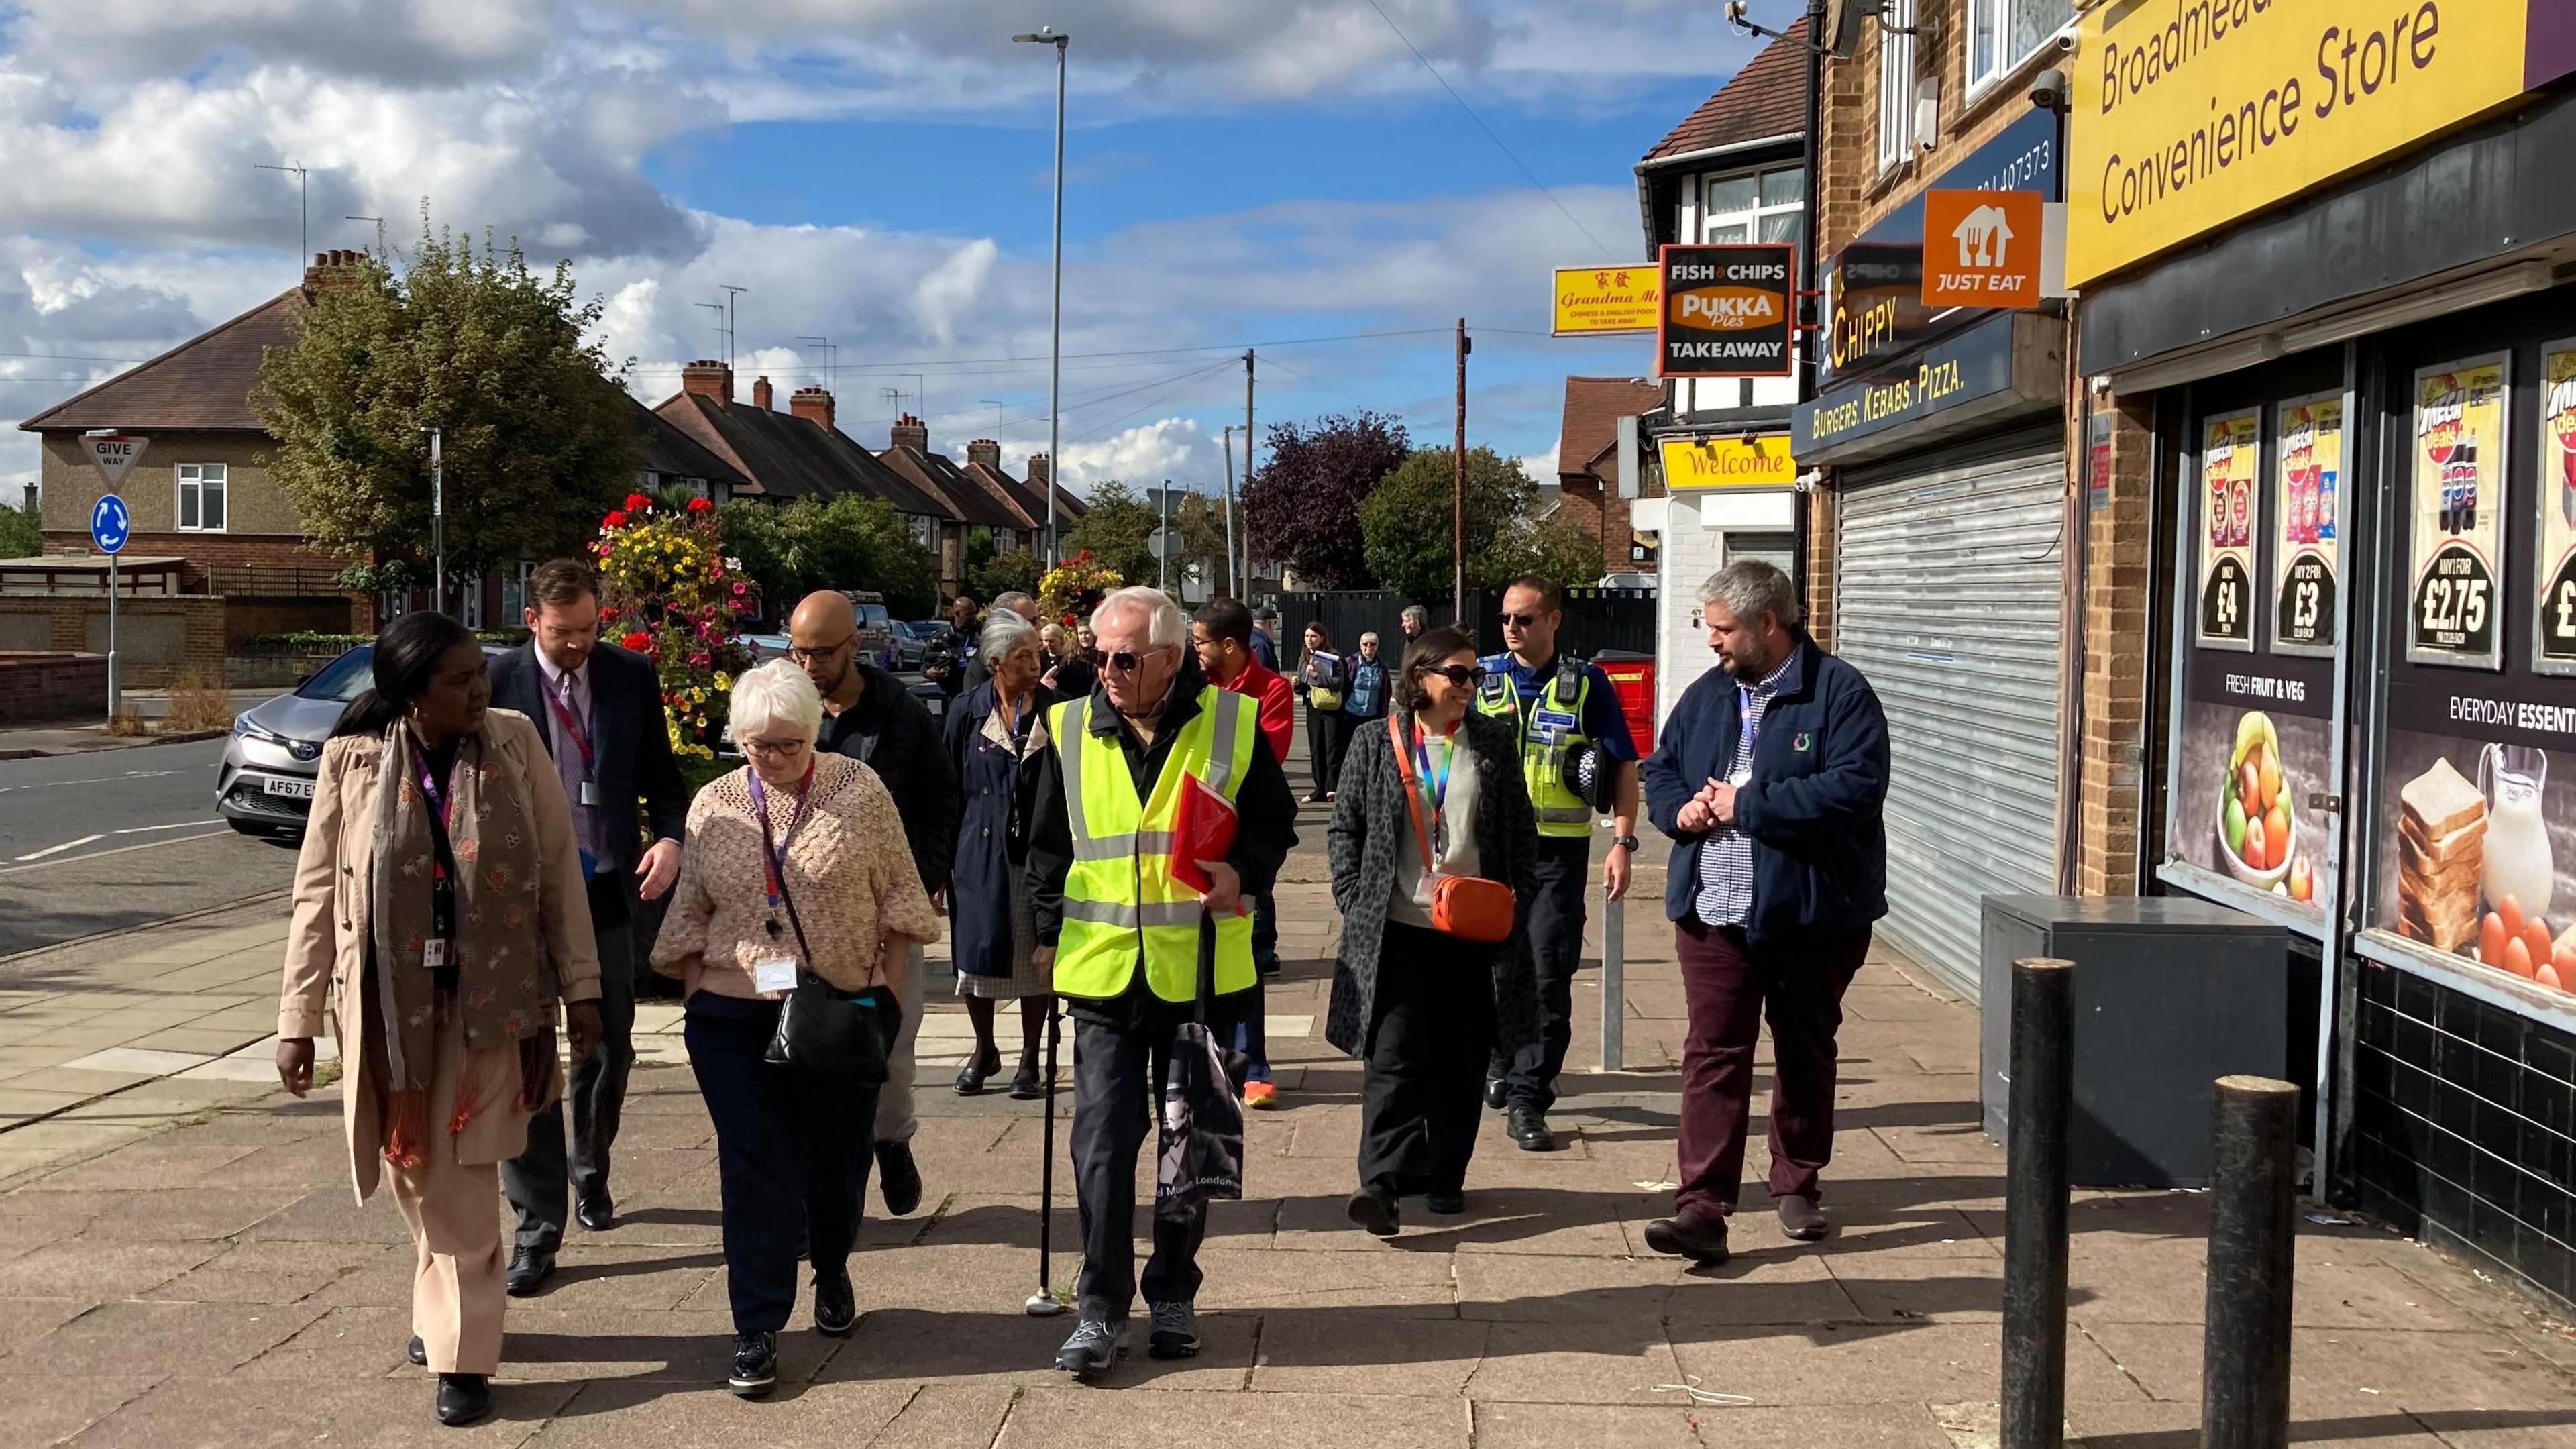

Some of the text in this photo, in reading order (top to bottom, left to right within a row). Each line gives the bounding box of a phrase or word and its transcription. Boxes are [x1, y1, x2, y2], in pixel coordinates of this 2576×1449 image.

[2102, 0, 2272, 115] Broadmea
[2101, 1, 2439, 224] Convenience Store
[1672, 265, 1785, 280] FISH & CHIPS
[1937, 274, 2026, 292] JUST EAT
[1562, 292, 1633, 309] Grandma
[1682, 294, 1772, 319] PUKKA
[1570, 310, 1599, 318] CHINESE
[1711, 313, 1744, 327] Pies
[1833, 296, 1896, 368] CHIPPY
[1670, 342, 1783, 358] TAKEAWAY
[1813, 360, 1964, 439] BURGERS. KEBABS. PIZZA.
[2419, 388, 2465, 437] MEGA
[2282, 420, 2314, 460] MEGA
[2426, 423, 2457, 447] deals
[97, 443, 131, 455] GIVE
[103, 457, 124, 466] WAY
[1685, 449, 1784, 475] Welcome
[2306, 565, 2310, 579] 2
[2310, 564, 2322, 579] FOR
[2439, 559, 2453, 575] ANY
[2456, 558, 2472, 575] FOR
[2217, 582, 2237, 623] £4
[2294, 582, 2318, 627] £3
[2424, 578, 2487, 633] £2.75
[2226, 674, 2304, 701] FRESH FRUIT & VEG
[2450, 696, 2576, 733] EVERYDAY ESSENT
[270, 780, 301, 794] AF67
[1196, 1175, 1232, 1186] London
